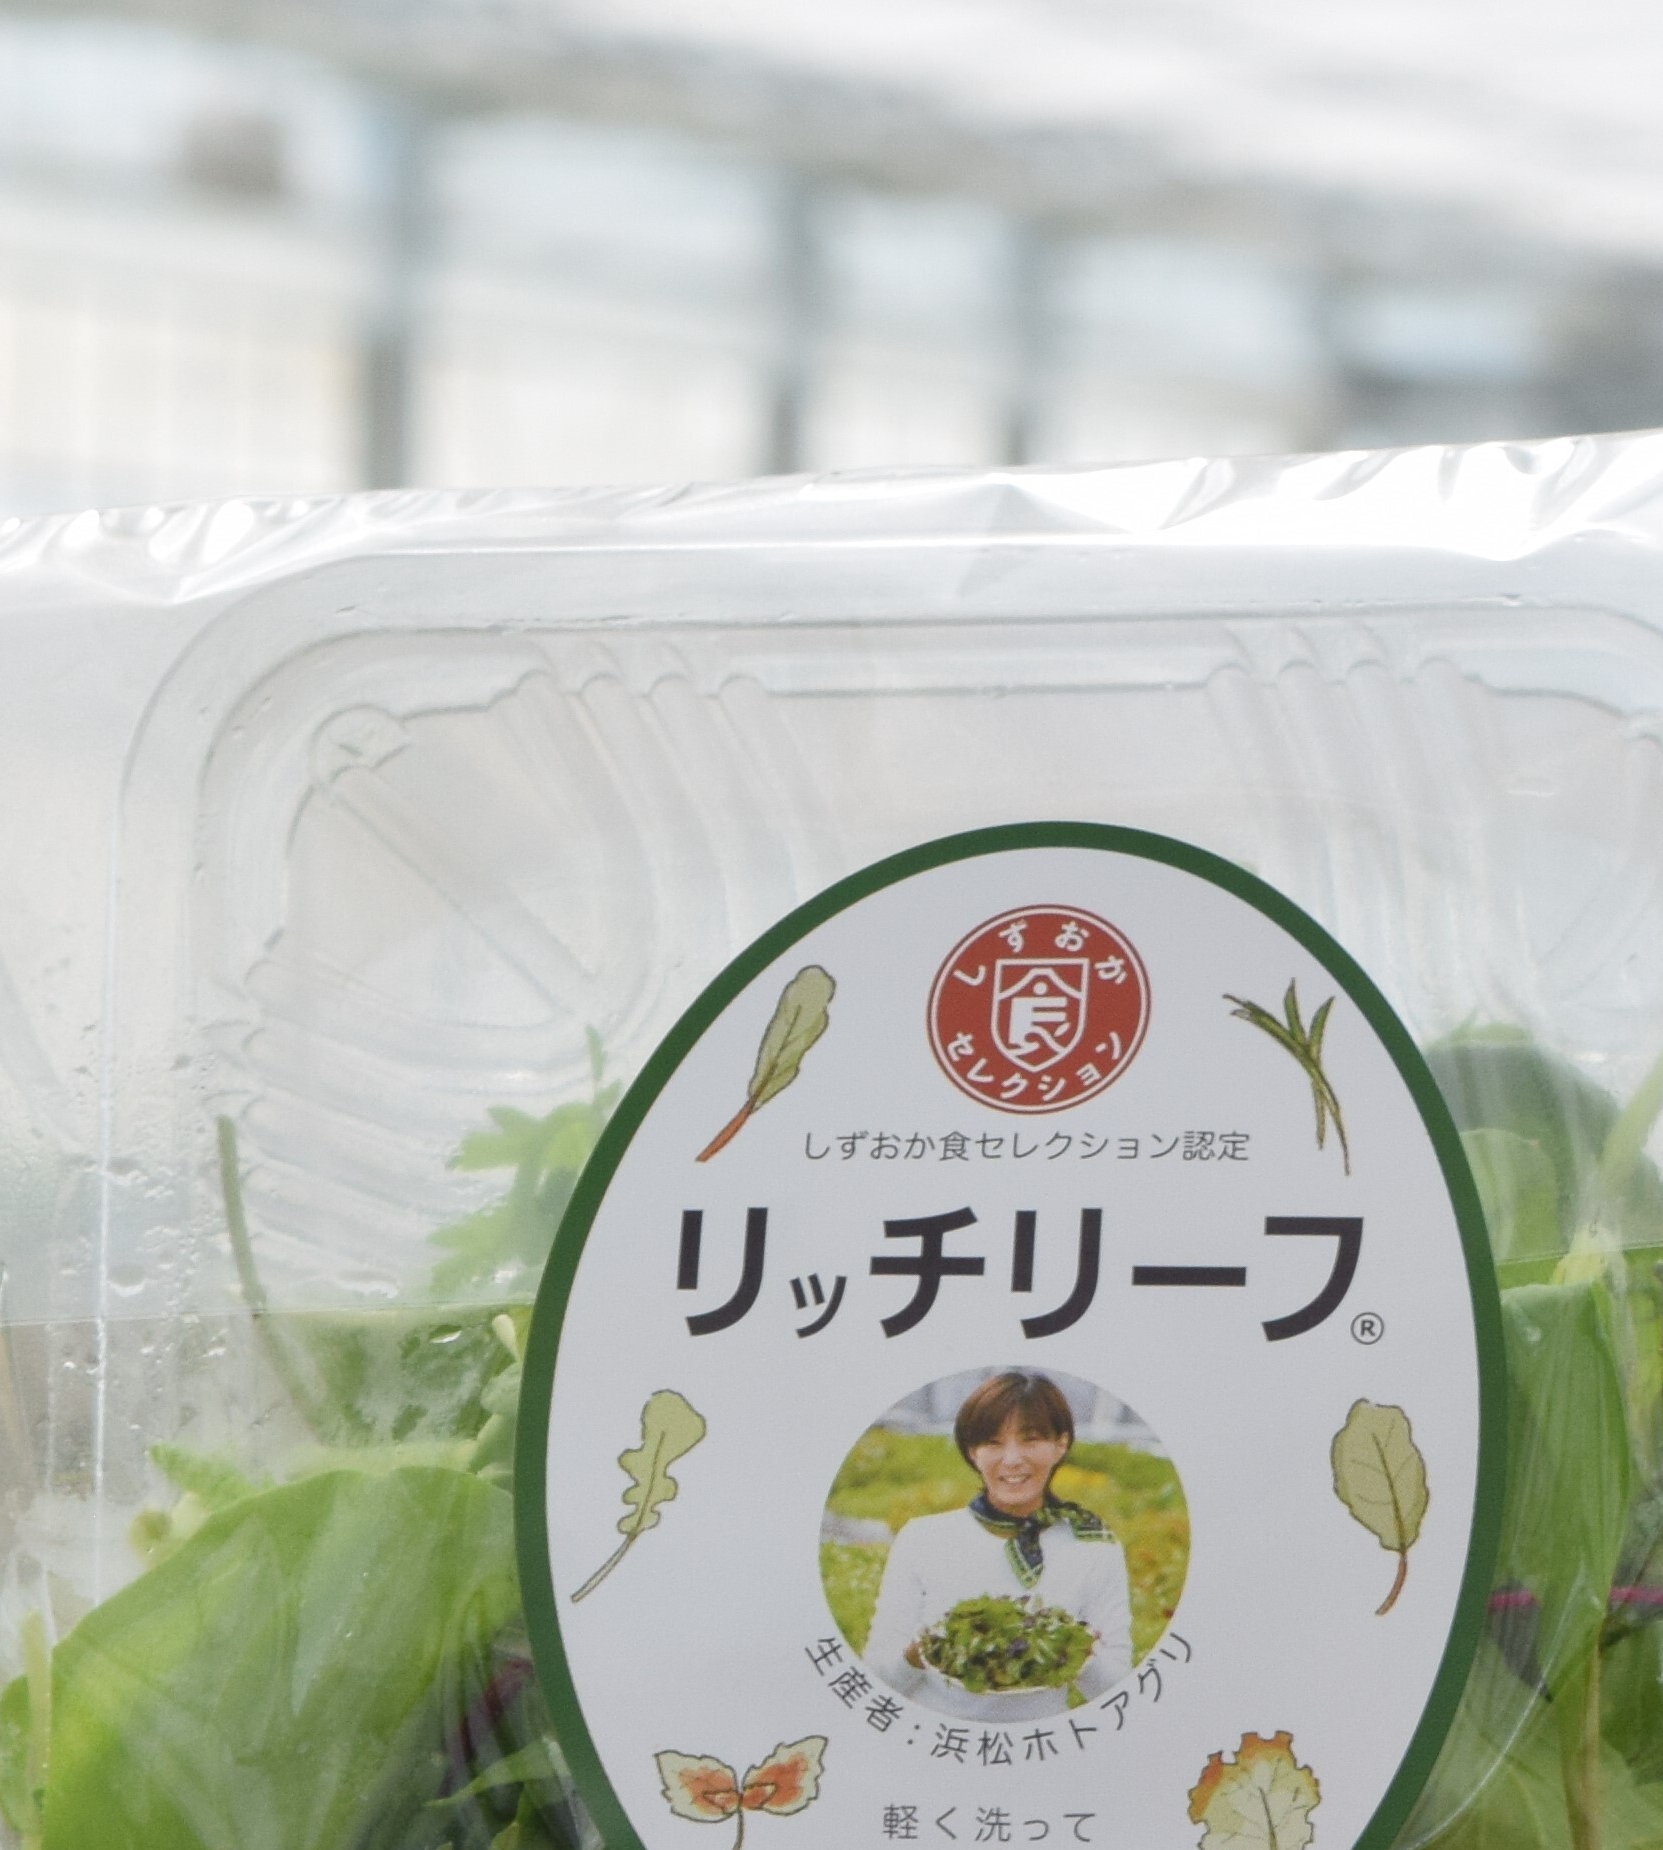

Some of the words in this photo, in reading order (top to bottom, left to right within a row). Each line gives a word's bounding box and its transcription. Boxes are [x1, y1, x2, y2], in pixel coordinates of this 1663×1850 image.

[952, 919, 1129, 985] しずおか
[946, 1031, 1123, 1102] セレクション
[803, 1130, 1252, 1162] しずおか食セレクション認定
[881, 1804, 1097, 1843] 軽く洗って
